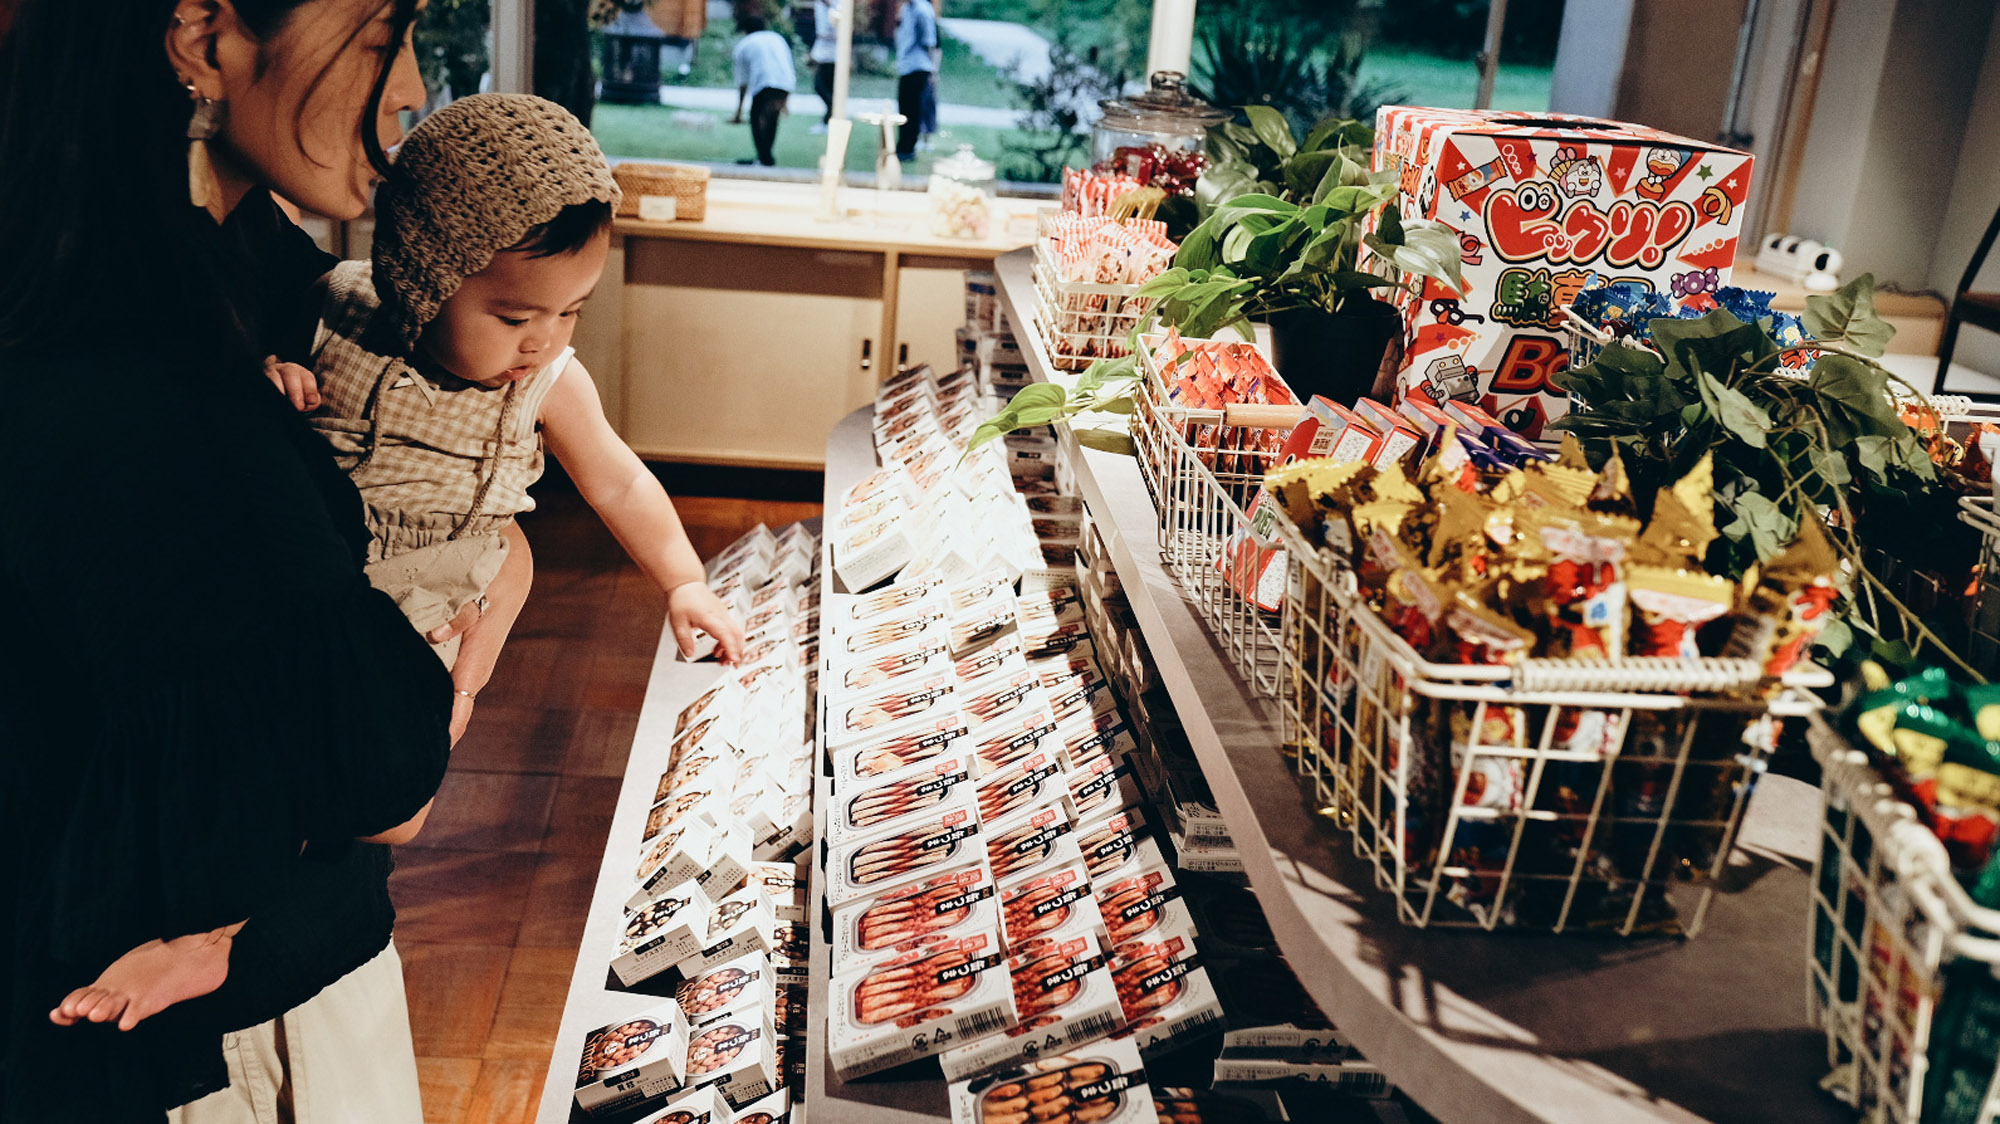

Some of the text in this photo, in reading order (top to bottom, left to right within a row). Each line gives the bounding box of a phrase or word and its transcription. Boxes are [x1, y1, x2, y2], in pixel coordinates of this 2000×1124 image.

[926, 830, 965, 849] 缶つま
[1020, 829, 1058, 853] 缶つま
[940, 892, 981, 912] 缶つま
[1037, 893, 1079, 914] 缶つま
[1126, 895, 1166, 917] 缶つま
[943, 960, 985, 981] 缶つま
[1046, 963, 1089, 987] 缶つま
[1145, 965, 1188, 988] 缶つま
[1081, 1075, 1129, 1098] 缶つま
